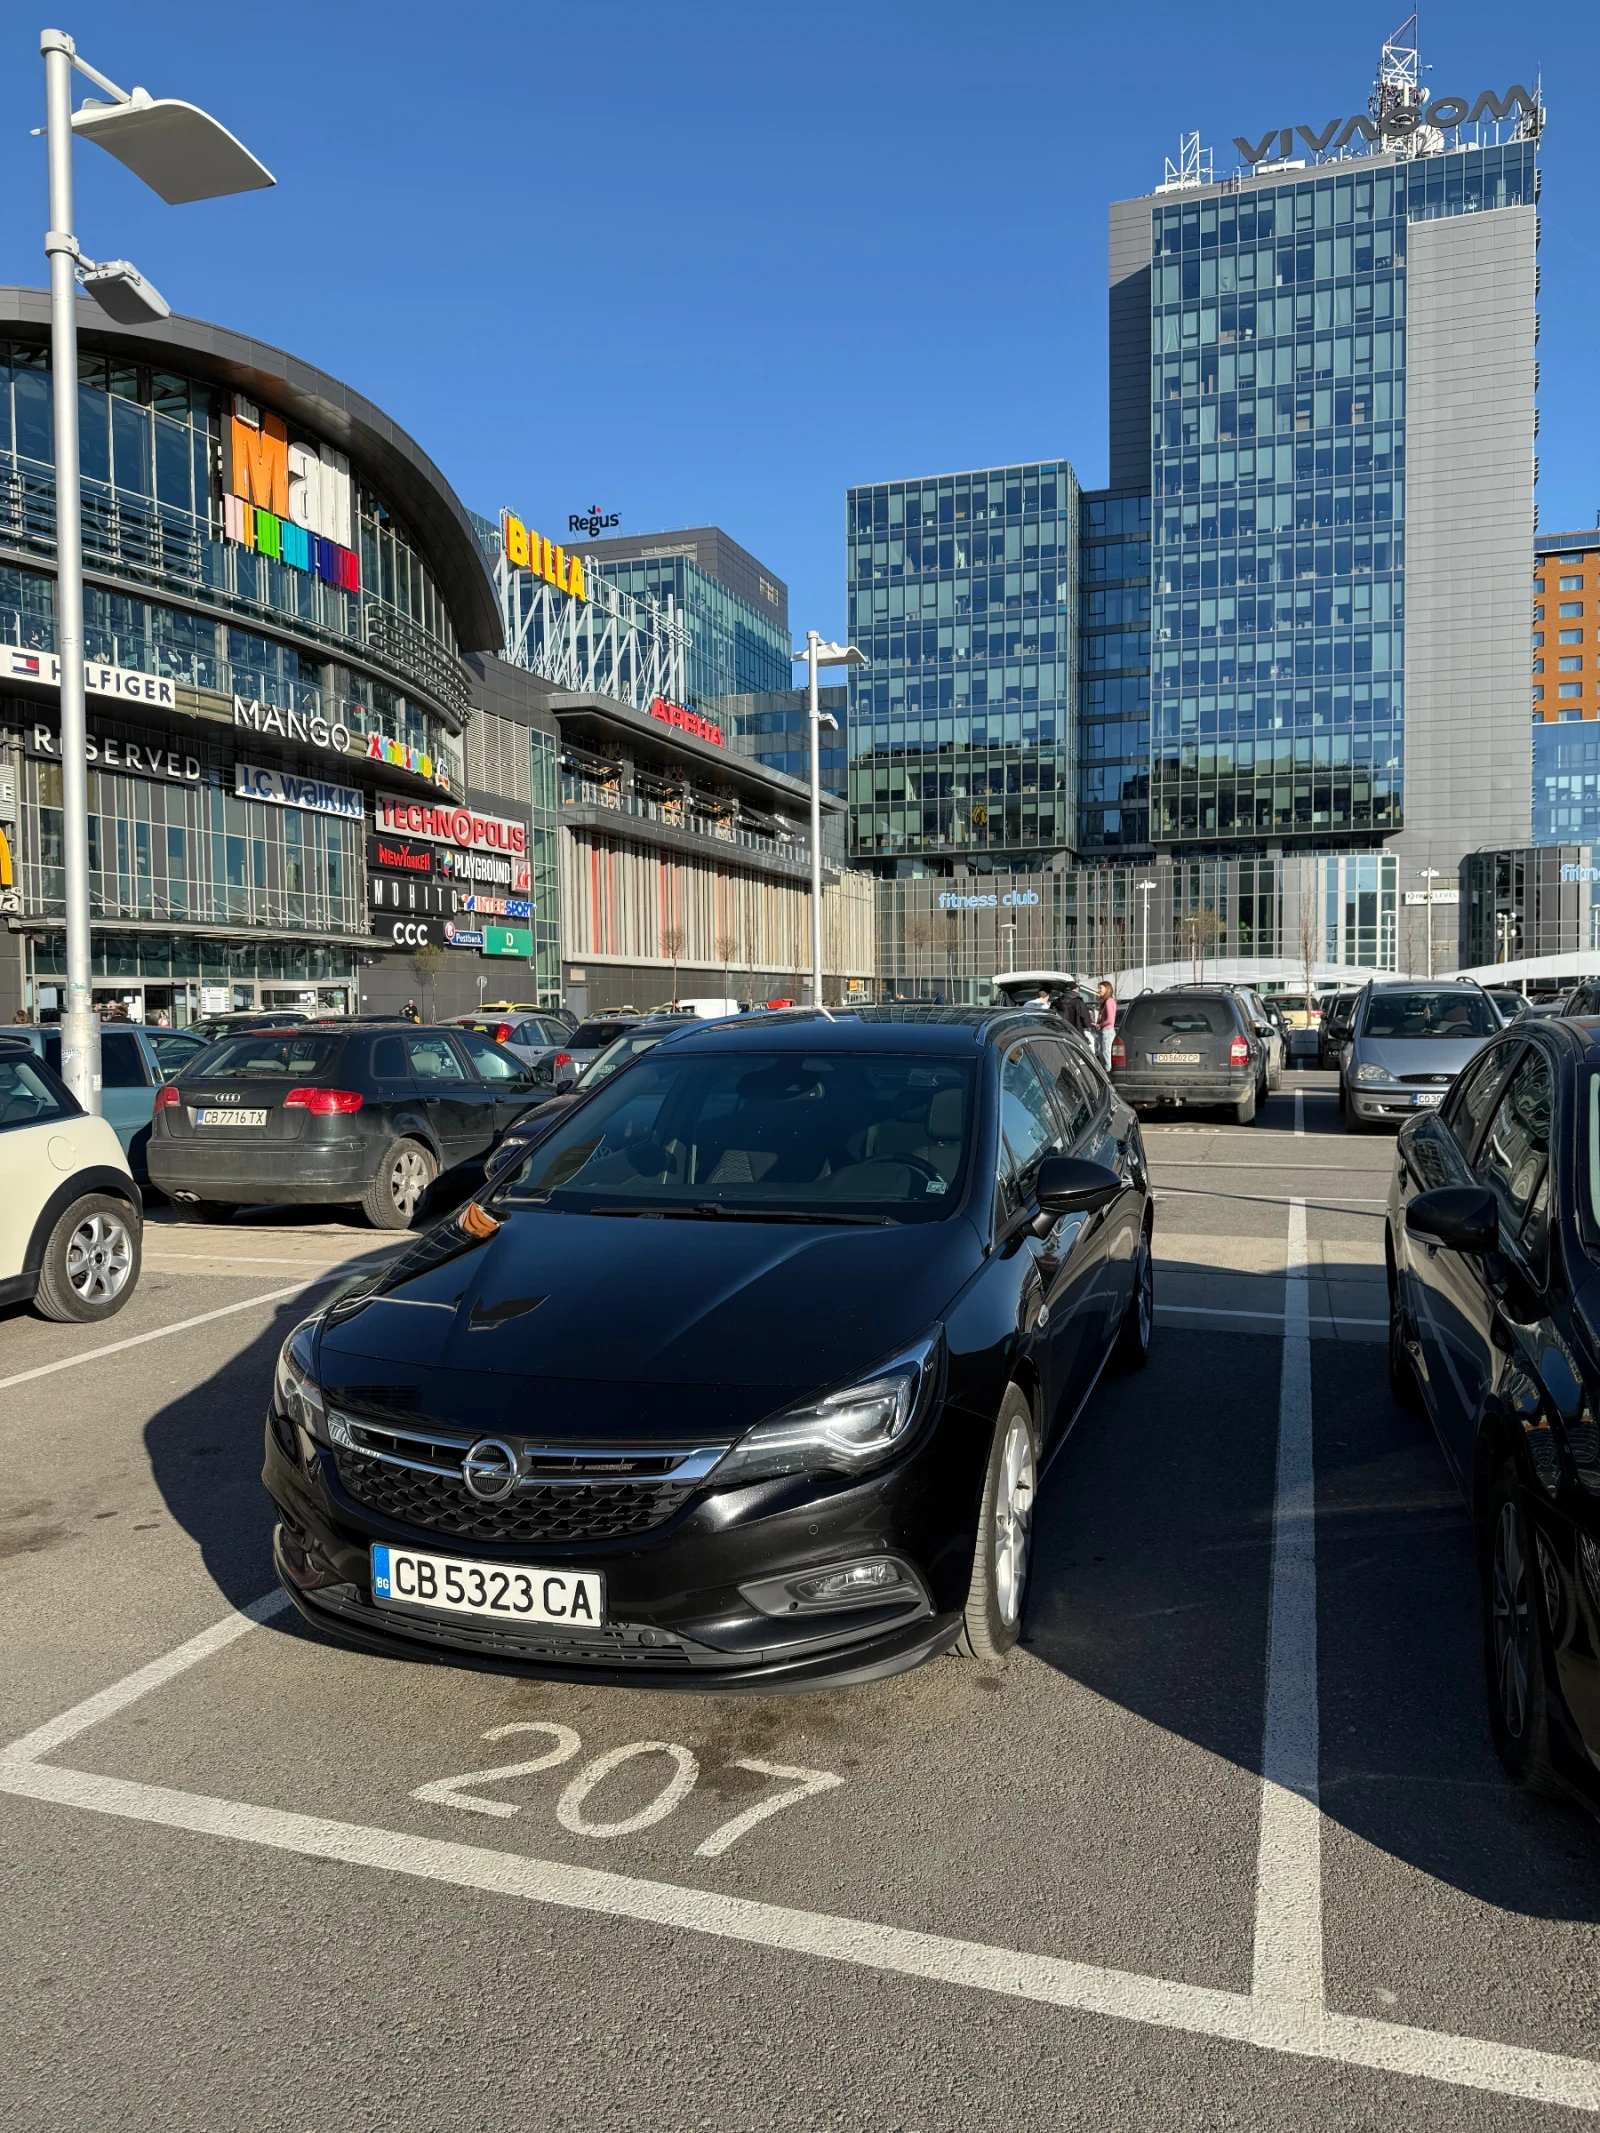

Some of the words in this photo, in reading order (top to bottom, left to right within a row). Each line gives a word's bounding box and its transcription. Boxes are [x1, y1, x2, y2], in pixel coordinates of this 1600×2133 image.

[1232, 84, 1536, 163] VIVACOM
[234, 394, 260, 428] the
[231, 395, 351, 549] Mall
[569, 513, 619, 537] Regus
[506, 515, 585, 602] BILLA
[52, 660, 172, 703] HLFIGER
[234, 694, 350, 752] MANGO
[34, 723, 200, 780] RSERVED
[242, 767, 272, 797] LC
[380, 797, 525, 852] TECHNOPOLIS
[455, 854, 511, 884] PLAYGROUND
[1560, 863, 1600, 882] fitn
[375, 879, 458, 913] MOHITO
[475, 895, 534, 918] INTERSPORT
[939, 893, 998, 908] fitness
[1002, 889, 1039, 906] club
[393, 922, 428, 946] CCC
[456, 932, 482, 944] Postbank
[204, 1111, 218, 1123] CB
[220, 1111, 247, 1123] 7716
[249, 1111, 264, 1124] TX
[377, 1576, 390, 1589] BG
[395, 1557, 438, 1599] CB
[445, 1564, 534, 1613] 5323
[543, 1577, 593, 1620] CA
[407, 1721, 845, 1857] 207
